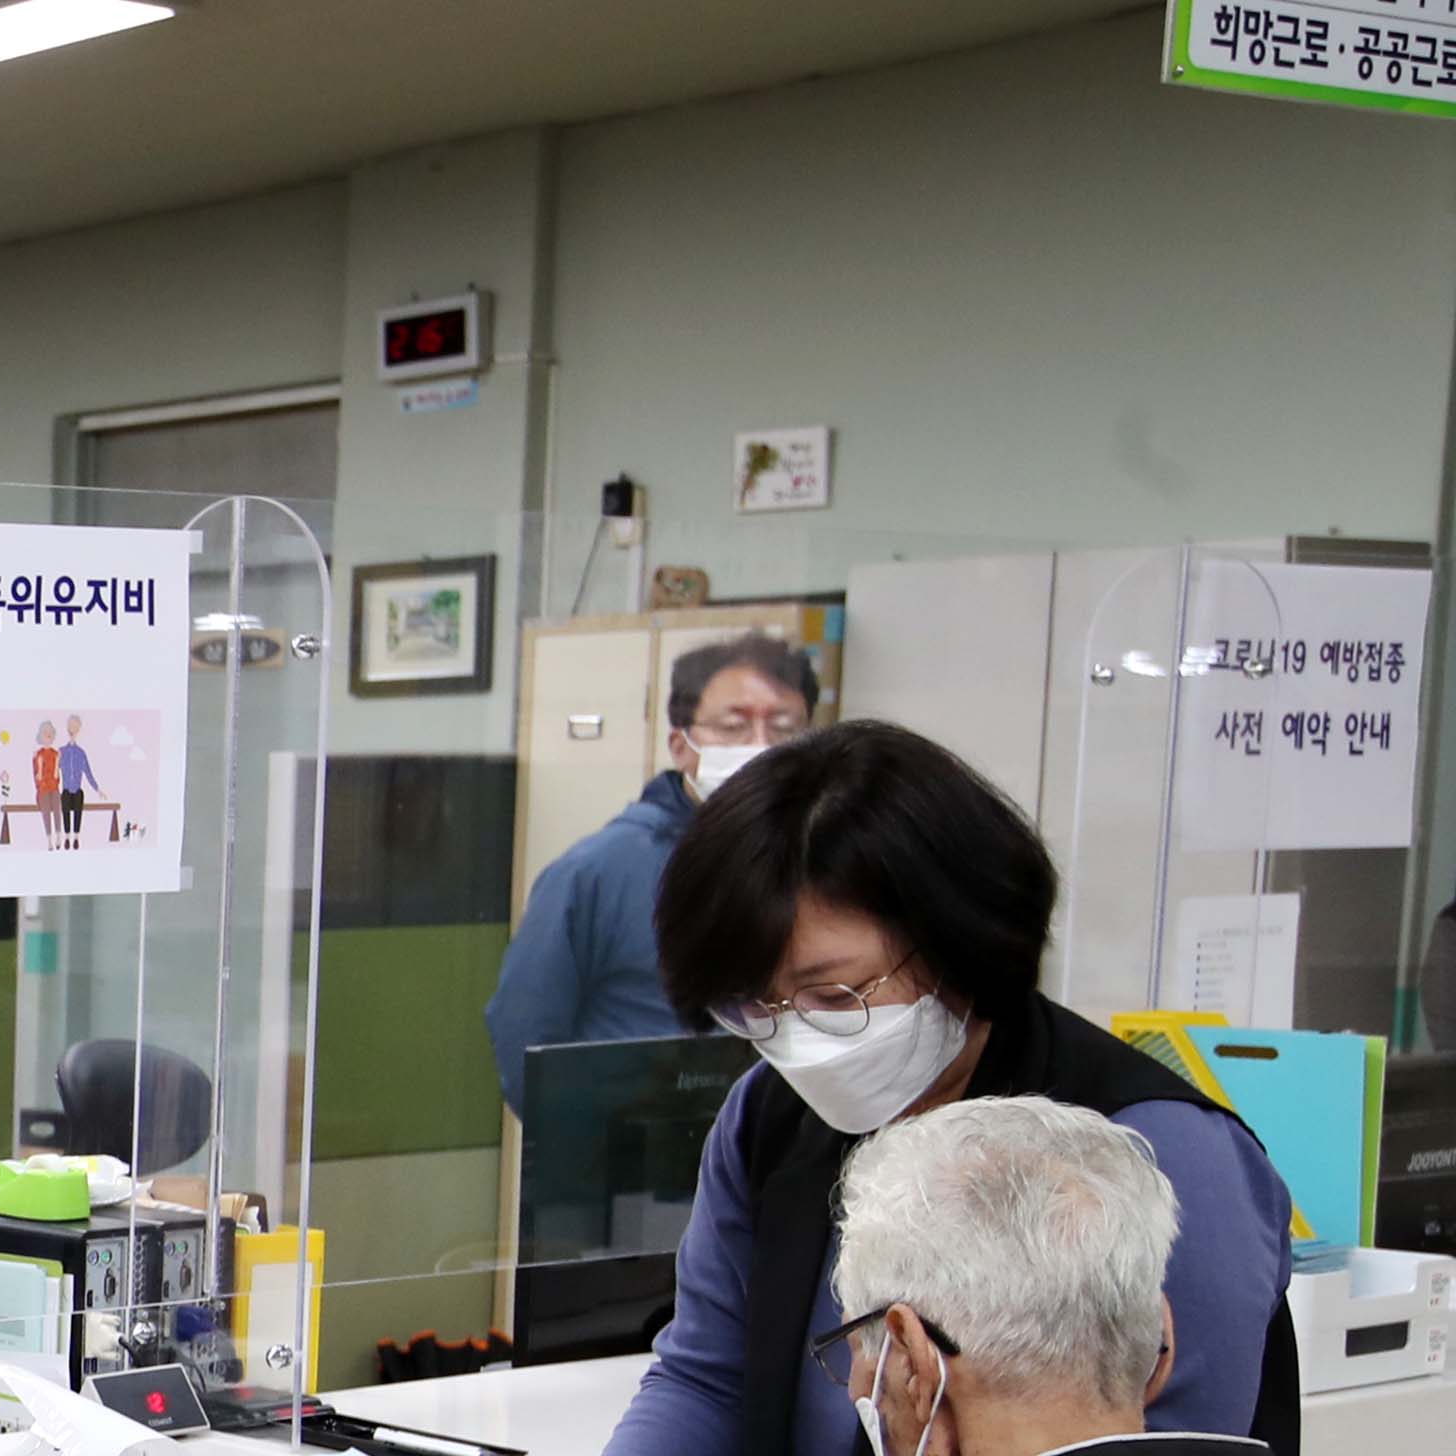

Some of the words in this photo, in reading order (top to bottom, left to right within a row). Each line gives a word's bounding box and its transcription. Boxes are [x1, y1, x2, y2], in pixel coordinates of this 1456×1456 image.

[1319, 640, 1406, 684] 예방접종
[1214, 710, 1264, 756] 사전
[1281, 711, 1331, 757] 예약
[1344, 710, 1392, 756] 안내
